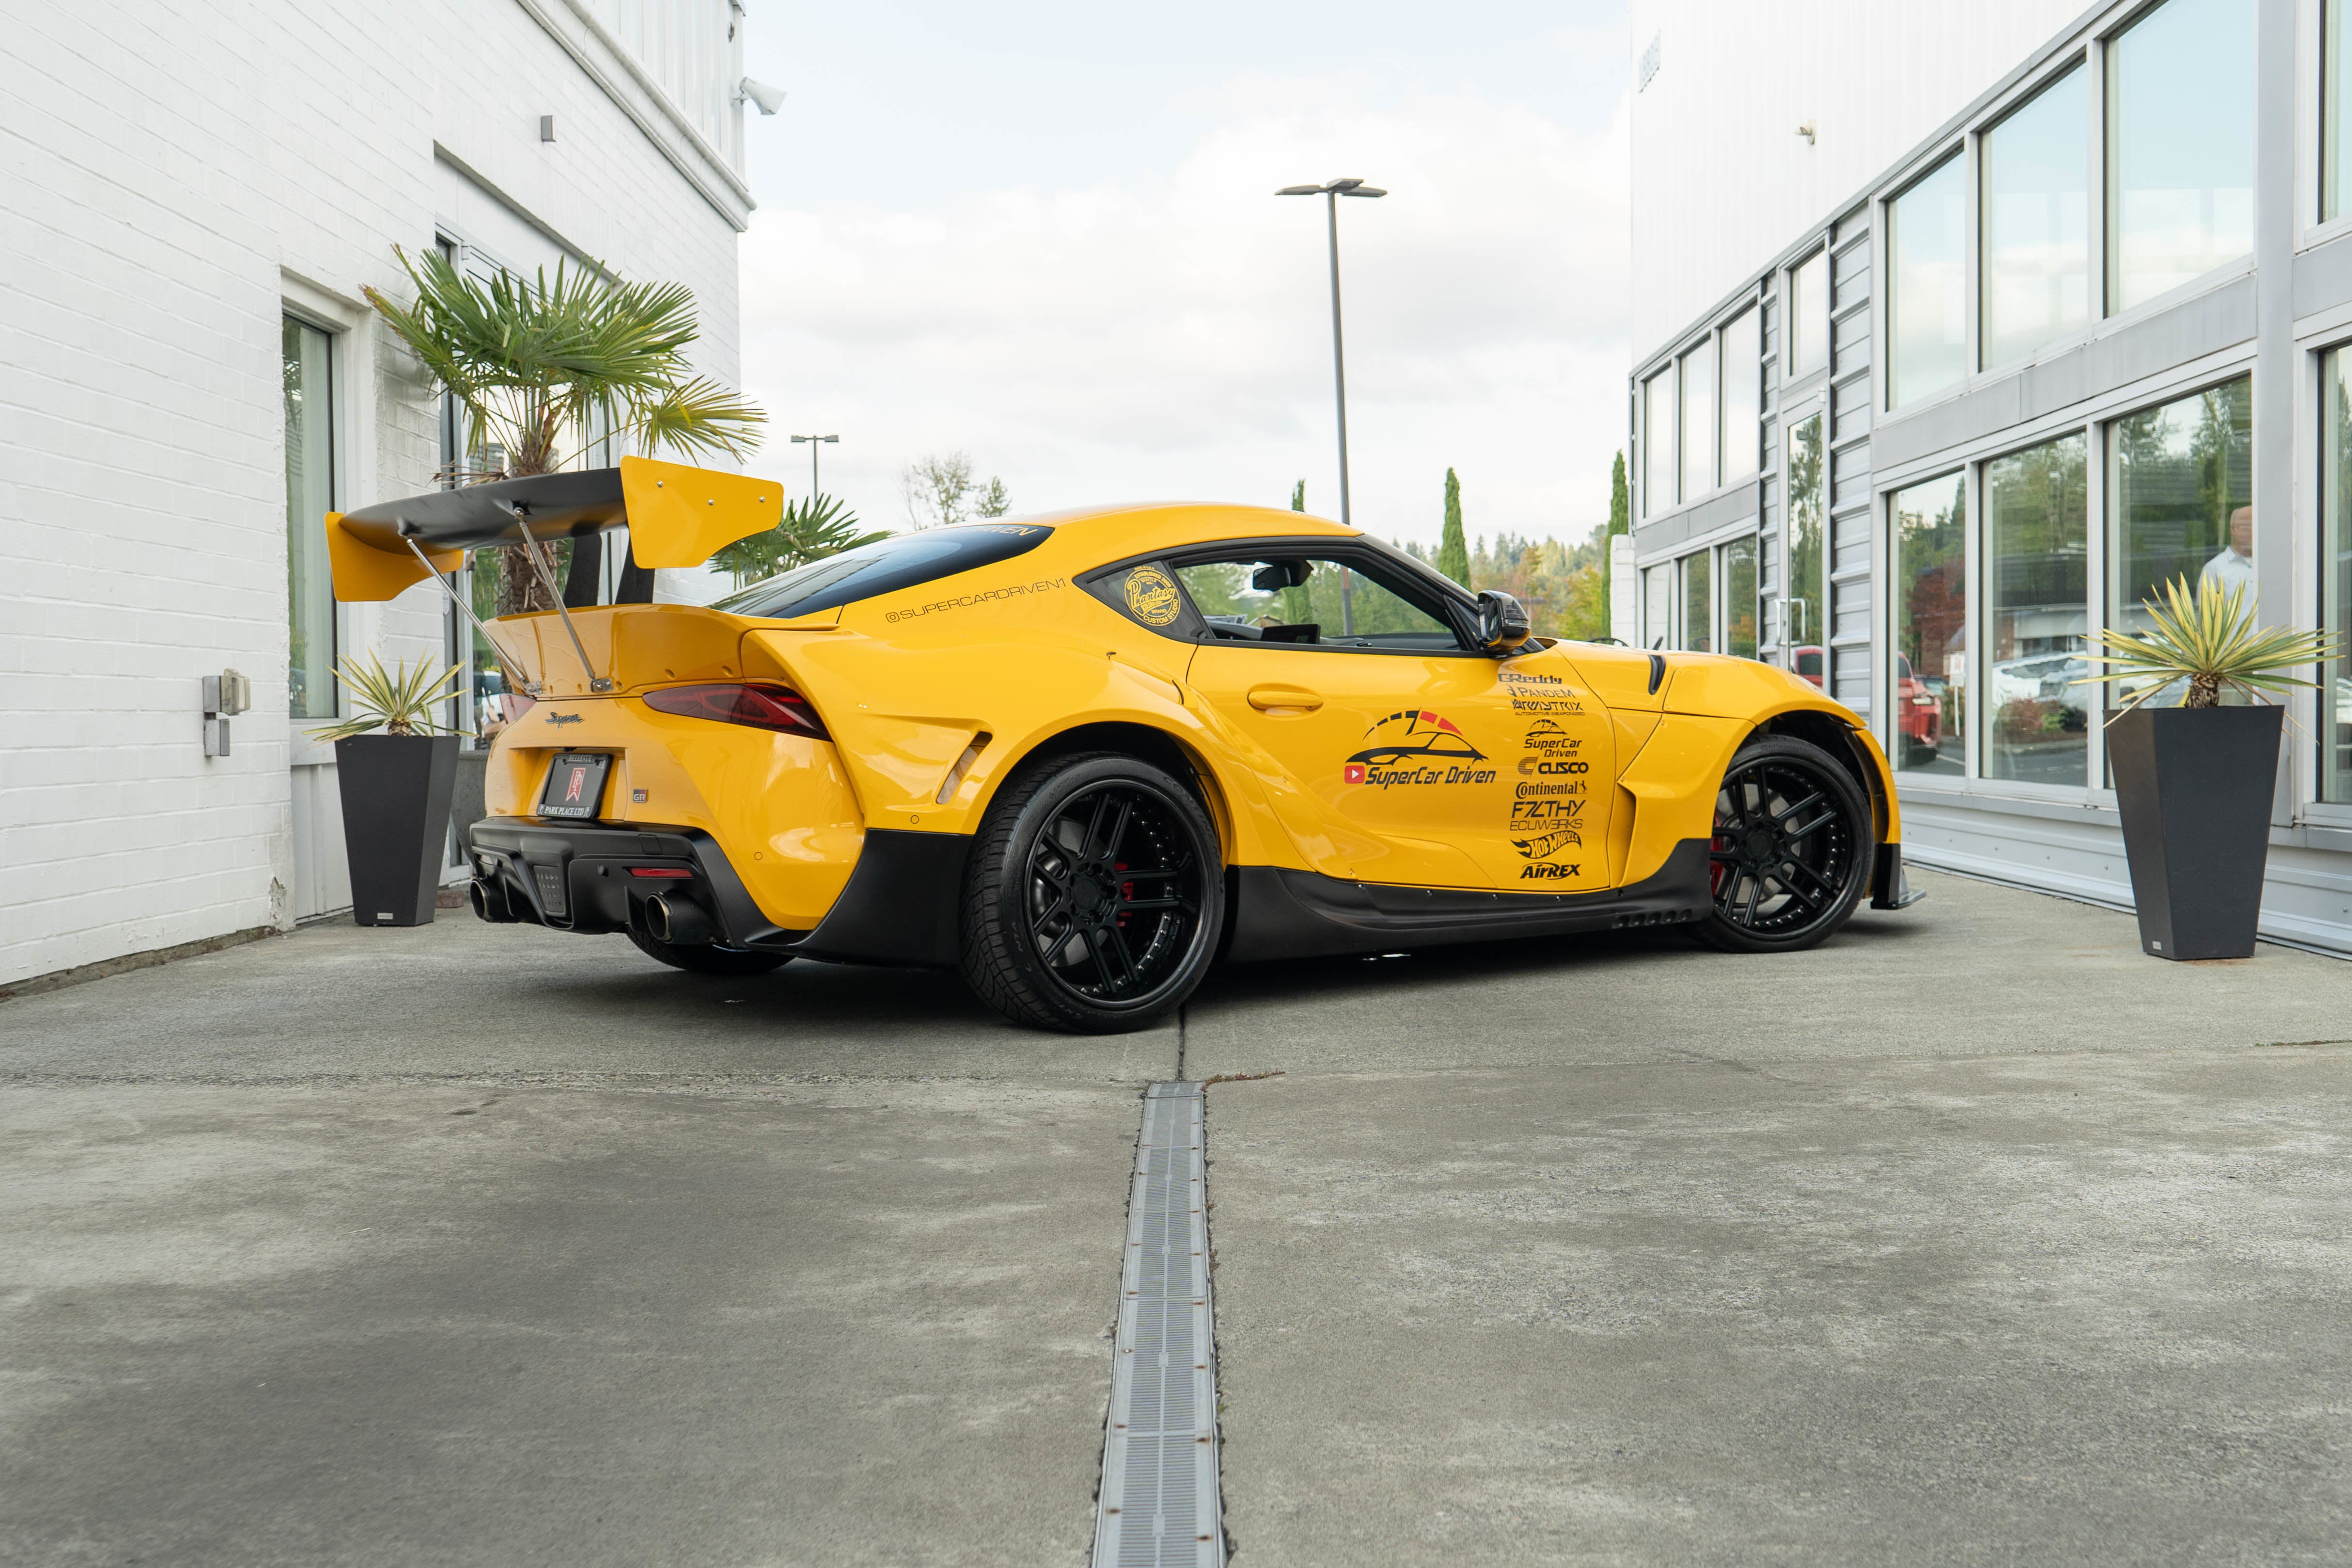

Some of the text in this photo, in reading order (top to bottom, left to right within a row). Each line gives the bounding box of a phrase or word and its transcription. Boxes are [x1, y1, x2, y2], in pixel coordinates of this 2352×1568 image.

[1127, 579, 1176, 609] Phantasy
[1143, 598, 1178, 624] CUSTOM STUDIO
[1498, 673, 1562, 684] GReddy
[1517, 686, 1576, 698] PANDEM
[545, 711, 585, 730] Supra
[1524, 738, 1582, 750] SuperCar
[568, 754, 593, 762] BELLEVUE
[1544, 749, 1578, 758] Driven
[1538, 762, 1589, 775] CUSCO
[1364, 766, 1496, 790] SuperCar Driven
[1515, 780, 1578, 800] Continental
[544, 806, 584, 816] PARK PLACE LTD
